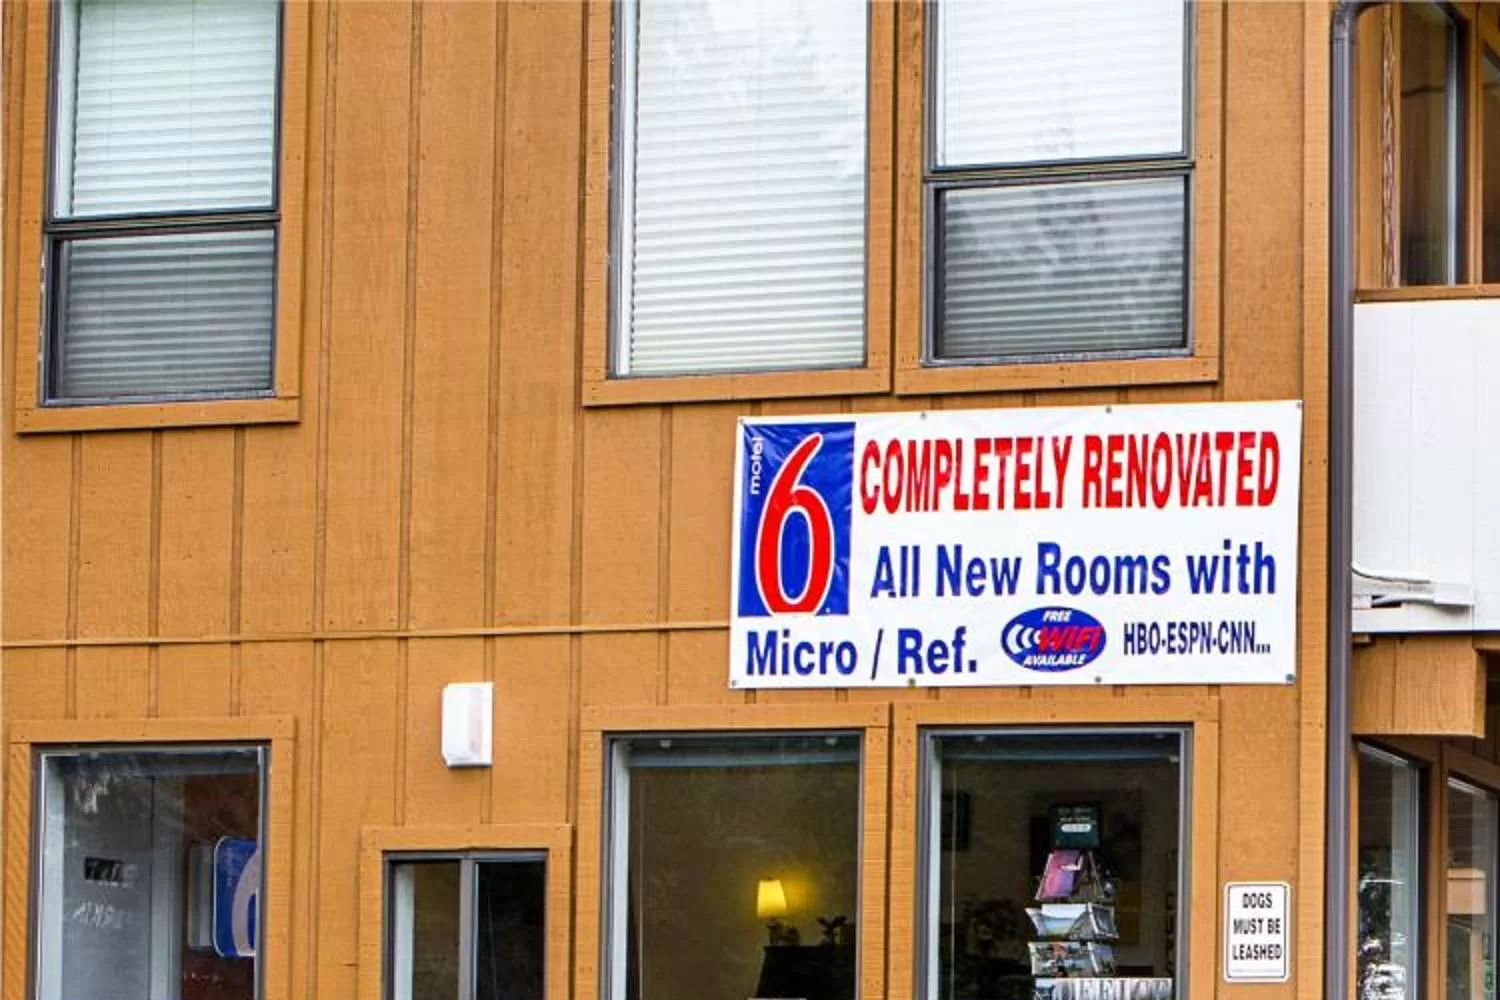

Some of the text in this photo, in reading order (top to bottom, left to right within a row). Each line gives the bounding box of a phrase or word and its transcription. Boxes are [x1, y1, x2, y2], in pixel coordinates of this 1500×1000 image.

[750, 436, 764, 495] motel
[860, 431, 1280, 514] COMPLETELY RENOVATED
[755, 432, 835, 616] 6
[870, 539, 1276, 598] All New Rooms with
[1043, 610, 1072, 622] FREE
[746, 626, 977, 680] Micro / Ref.
[1024, 653, 1087, 666] AVAILABLE
[1242, 892, 1273, 909] DOGS
[1233, 917, 1281, 935] MUST BE
[1232, 944, 1283, 960] LEASHED
